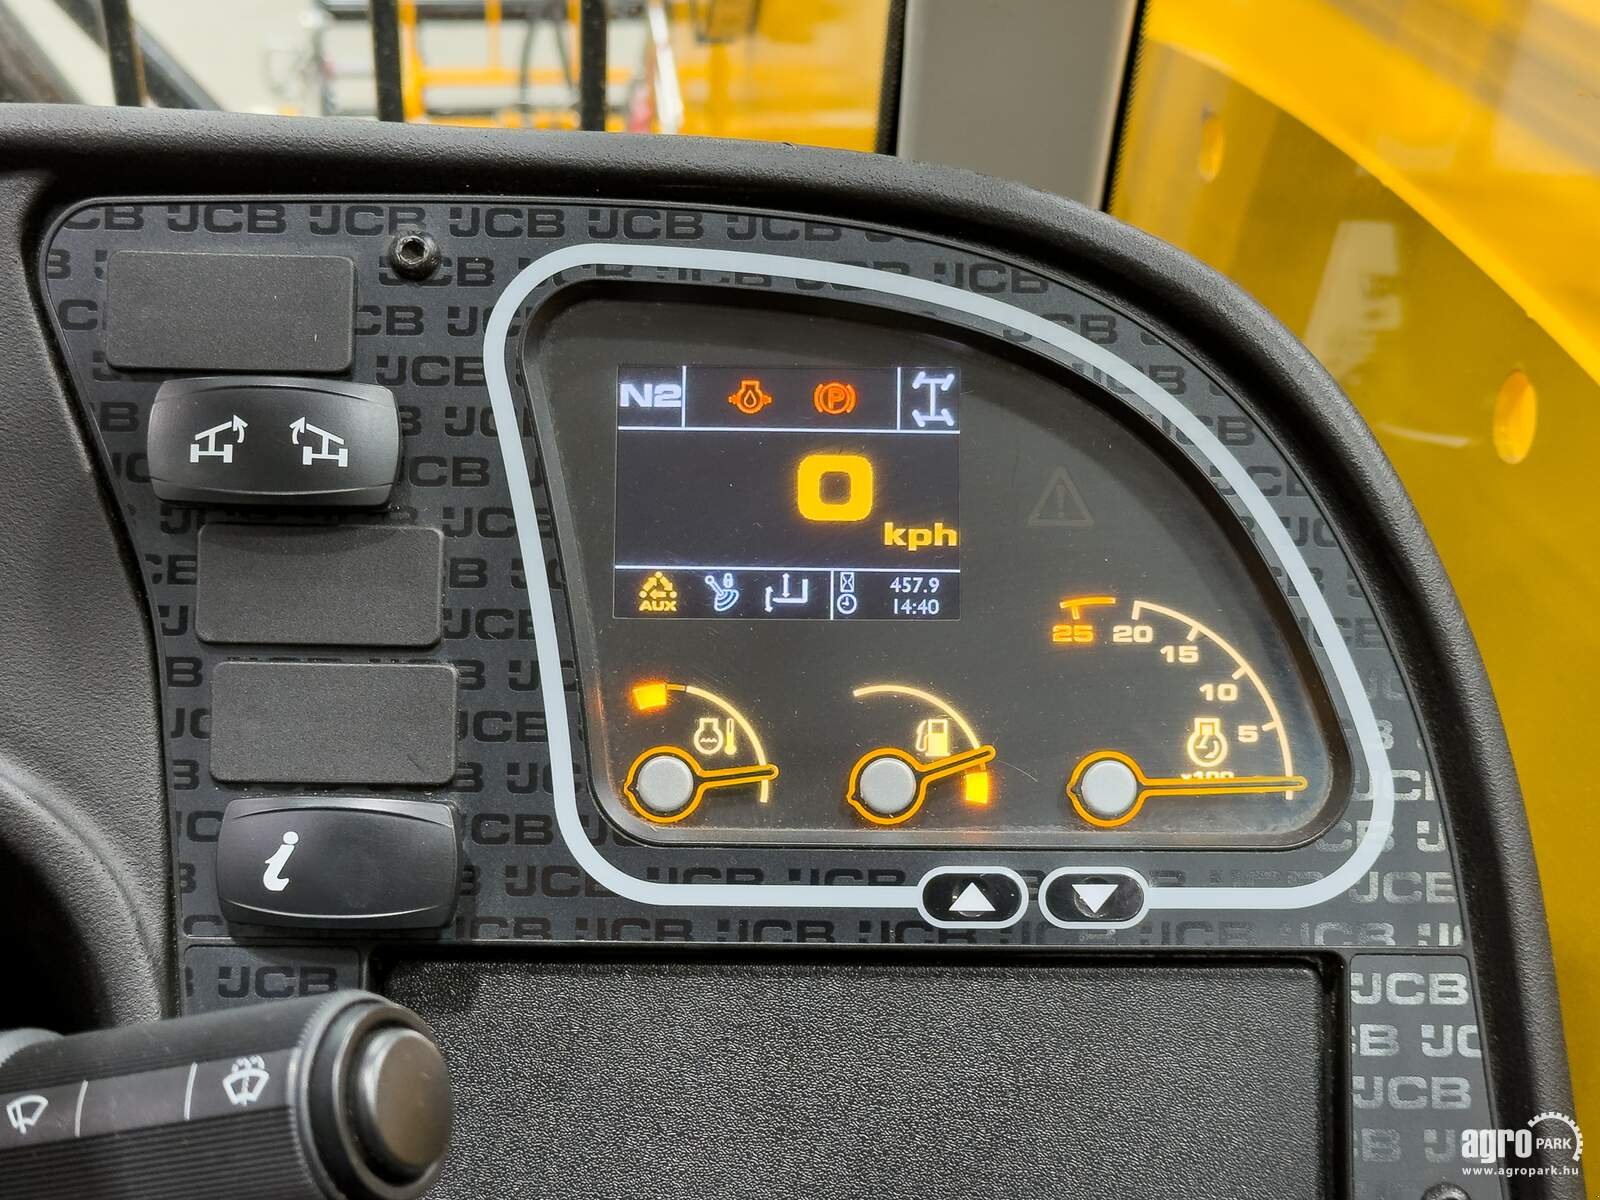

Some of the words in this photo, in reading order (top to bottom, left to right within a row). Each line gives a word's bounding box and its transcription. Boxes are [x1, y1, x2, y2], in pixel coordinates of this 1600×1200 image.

[64, 204, 145, 231] CB
[167, 204, 288, 234] JCB
[450, 207, 566, 239] JCB
[587, 208, 703, 240] JCB
[354, 305, 425, 336] CB
[620, 383, 682, 407] N2
[406, 456, 489, 488] CB
[797, 454, 874, 522] 0
[884, 522, 958, 551] kph
[889, 577, 940, 594] 457.9
[639, 600, 677, 612] AUX
[892, 599, 940, 615] 14:40
[1052, 624, 1094, 643] 25
[1112, 625, 1154, 643] 20
[1160, 646, 1199, 664] 15
[1199, 683, 1239, 701] 10
[1237, 725, 1259, 743] 5
[471, 813, 553, 845] CB
[218, 966, 337, 998] JCB
[1351, 972, 1470, 1005] JCB
[1421, 1024, 1481, 1057] JC
[1352, 1076, 1472, 1110] JCB
